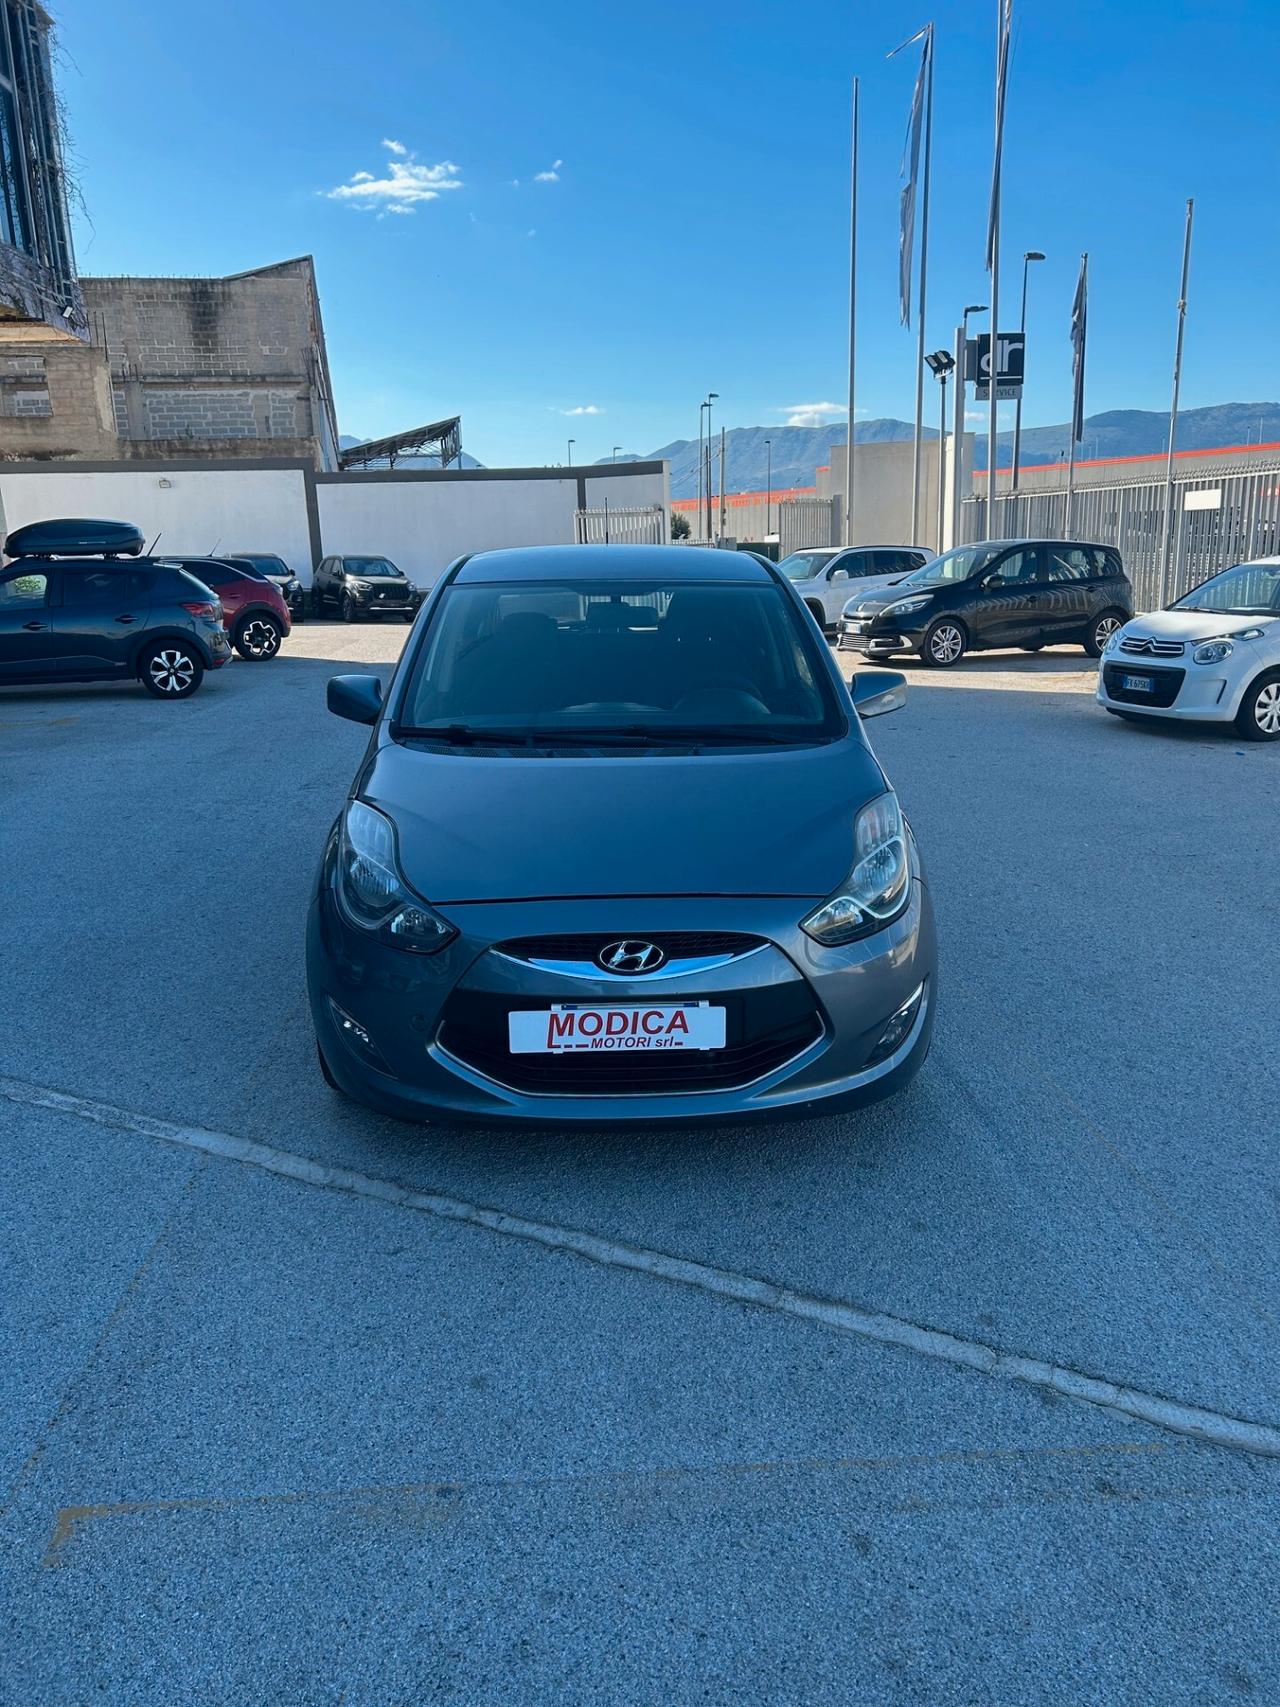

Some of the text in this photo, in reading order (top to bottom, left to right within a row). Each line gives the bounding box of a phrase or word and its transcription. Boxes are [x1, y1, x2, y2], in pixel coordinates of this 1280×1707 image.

[981, 340, 1023, 372] dr
[983, 388, 1017, 397] SVICE
[549, 1010, 689, 1037] MODICA
[591, 1036, 673, 1048] MOTORI srl
